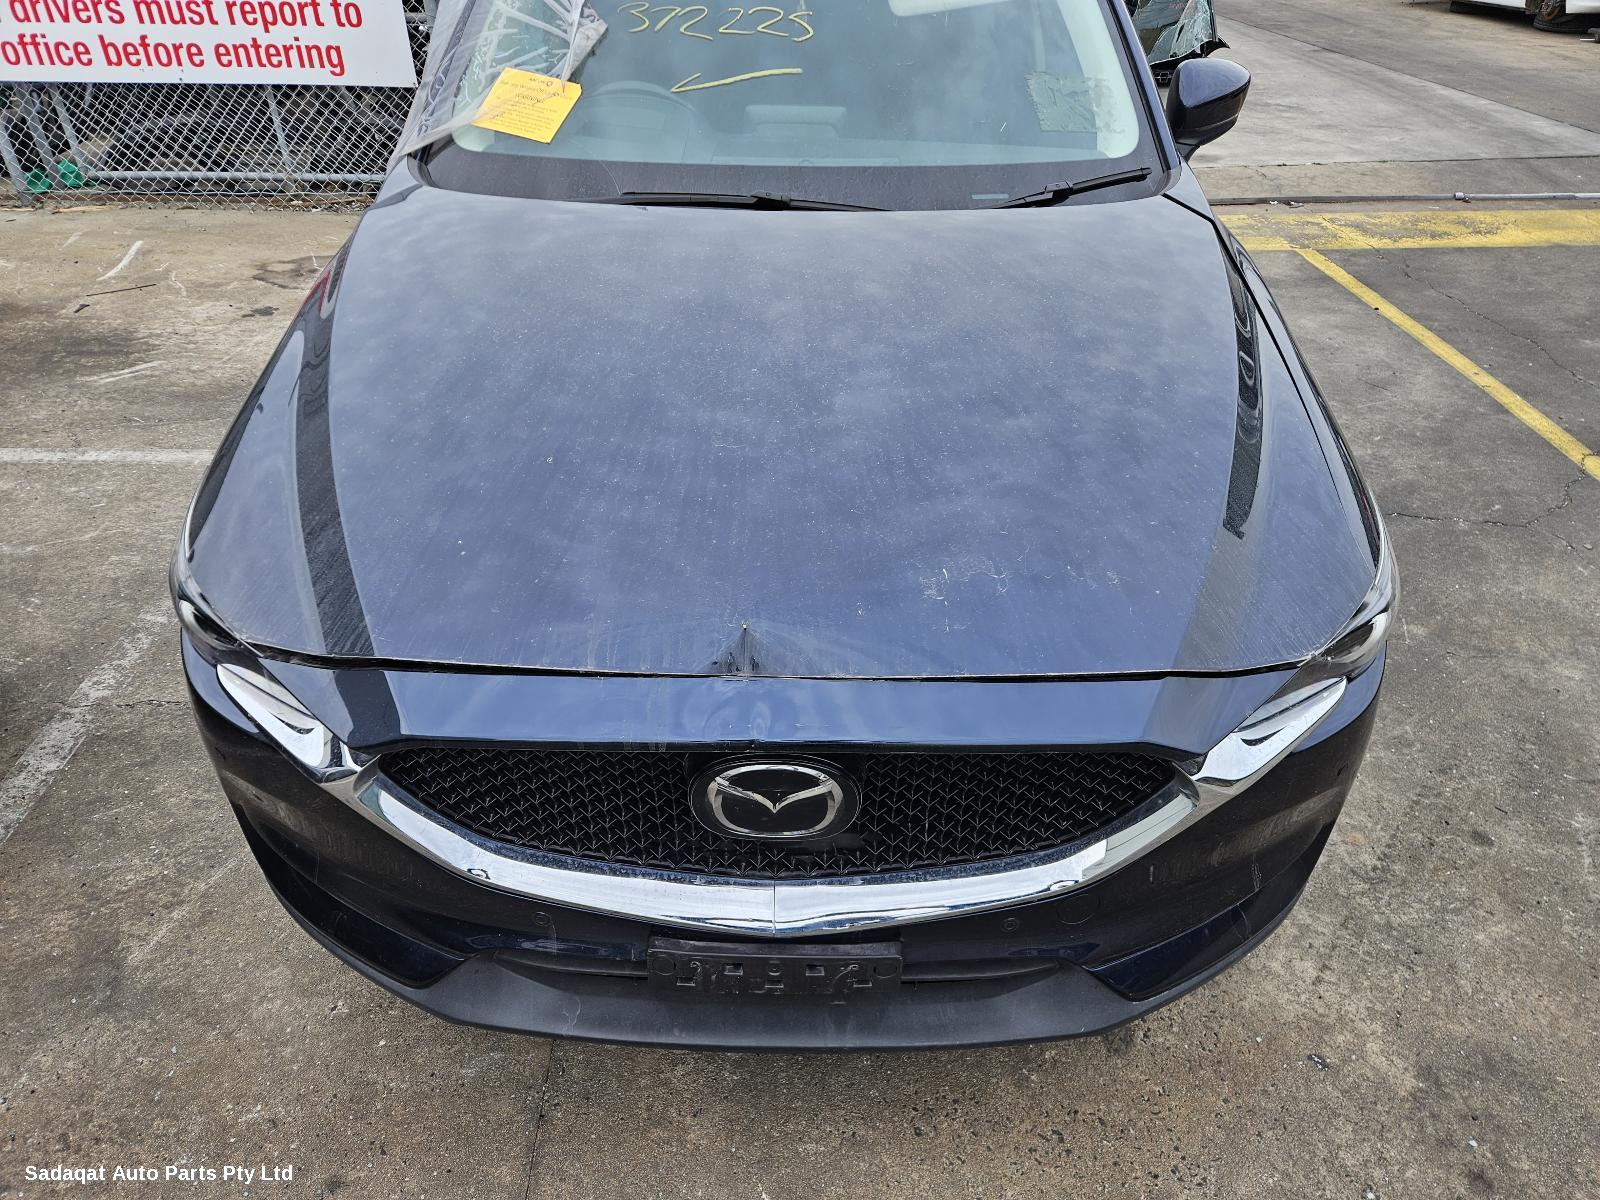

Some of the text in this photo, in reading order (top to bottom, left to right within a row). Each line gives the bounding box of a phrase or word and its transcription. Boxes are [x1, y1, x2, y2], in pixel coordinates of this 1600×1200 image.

[9, 0, 363, 34] drivers must report to
[0, 33, 346, 78] office before entering
